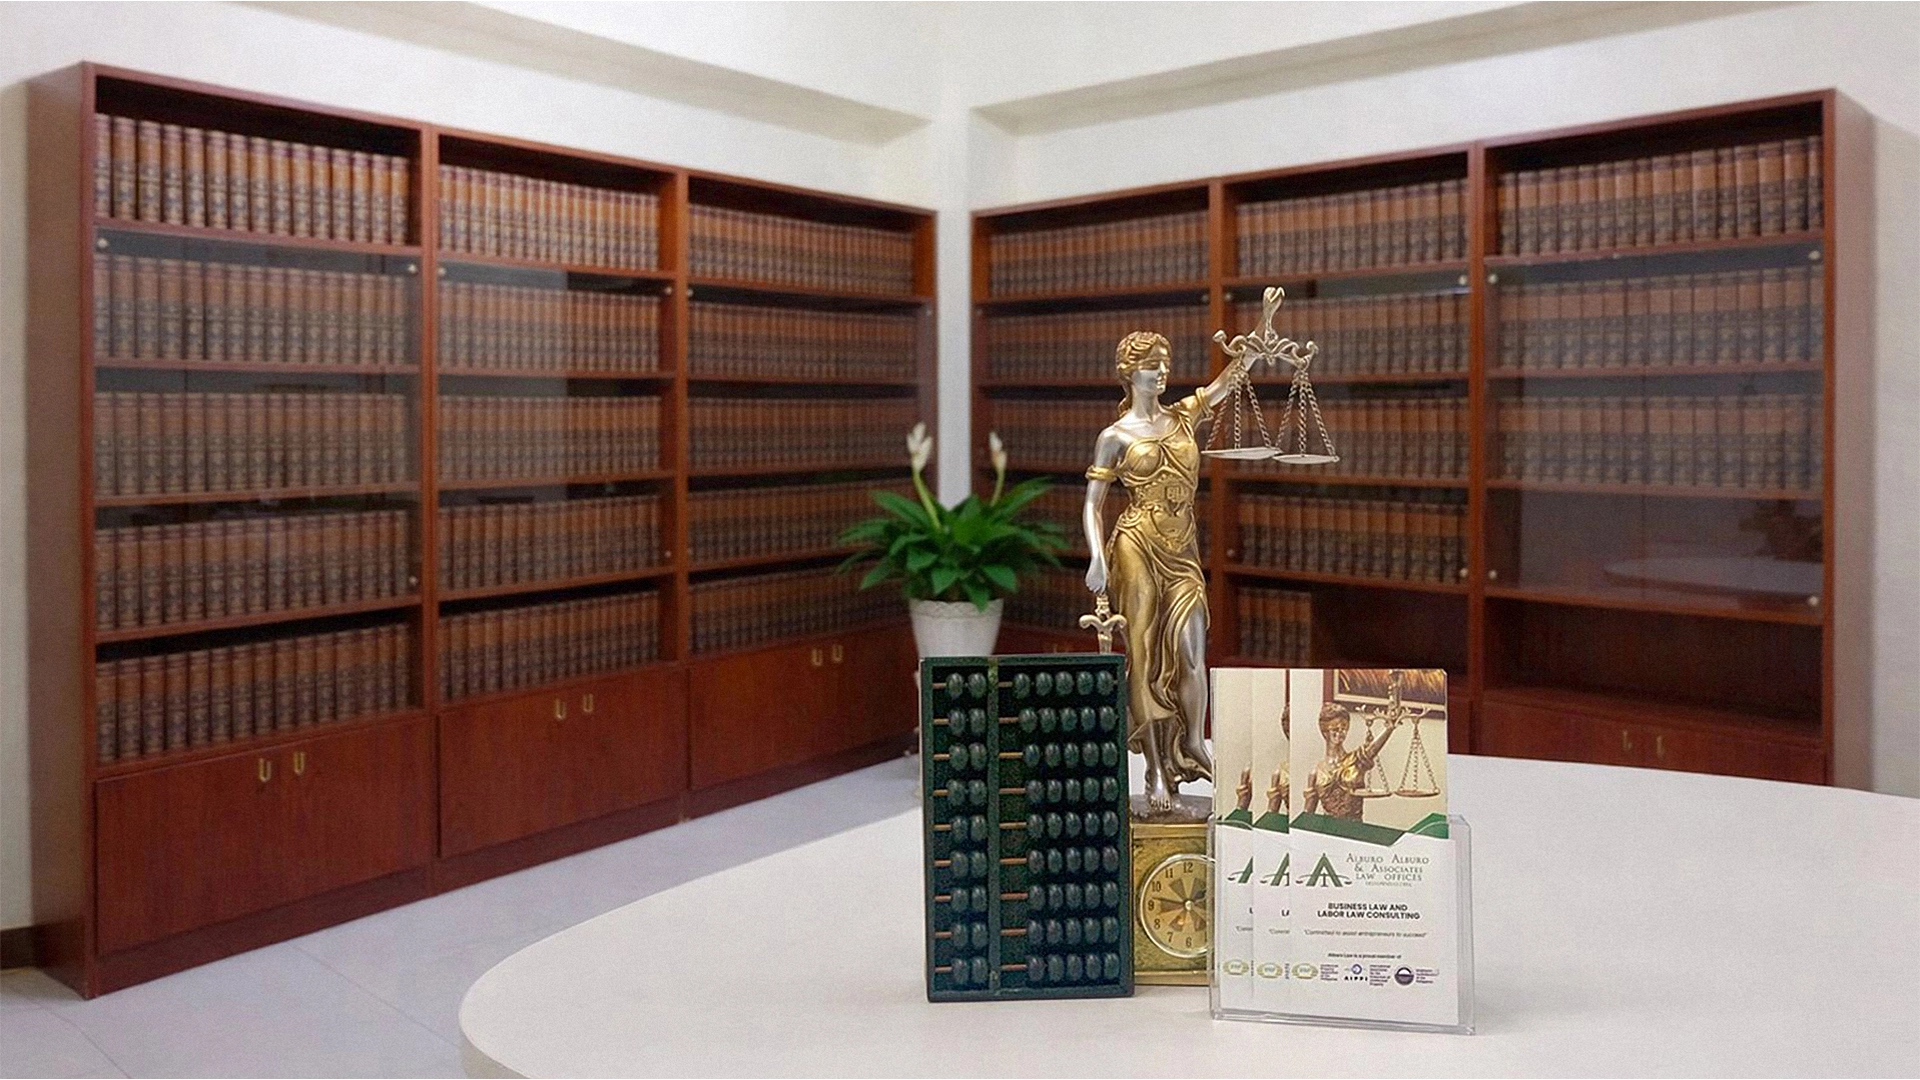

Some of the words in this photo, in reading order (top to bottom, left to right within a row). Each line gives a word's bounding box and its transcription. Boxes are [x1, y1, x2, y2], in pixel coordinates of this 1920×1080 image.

[1183, 862, 1193, 873] 12
[1354, 863, 1364, 873] &
[1165, 868, 1174, 879] 11
[1384, 873, 1422, 881] OFFICES
[1151, 881, 1162, 892] 10
[1147, 900, 1155, 911] 9
[1369, 903, 1388, 911] LAW
[1317, 910, 1345, 918] LABOR
[1154, 918, 1161, 930] 8
[1167, 931, 1173, 943] 7
[1185, 937, 1192, 947] 6
